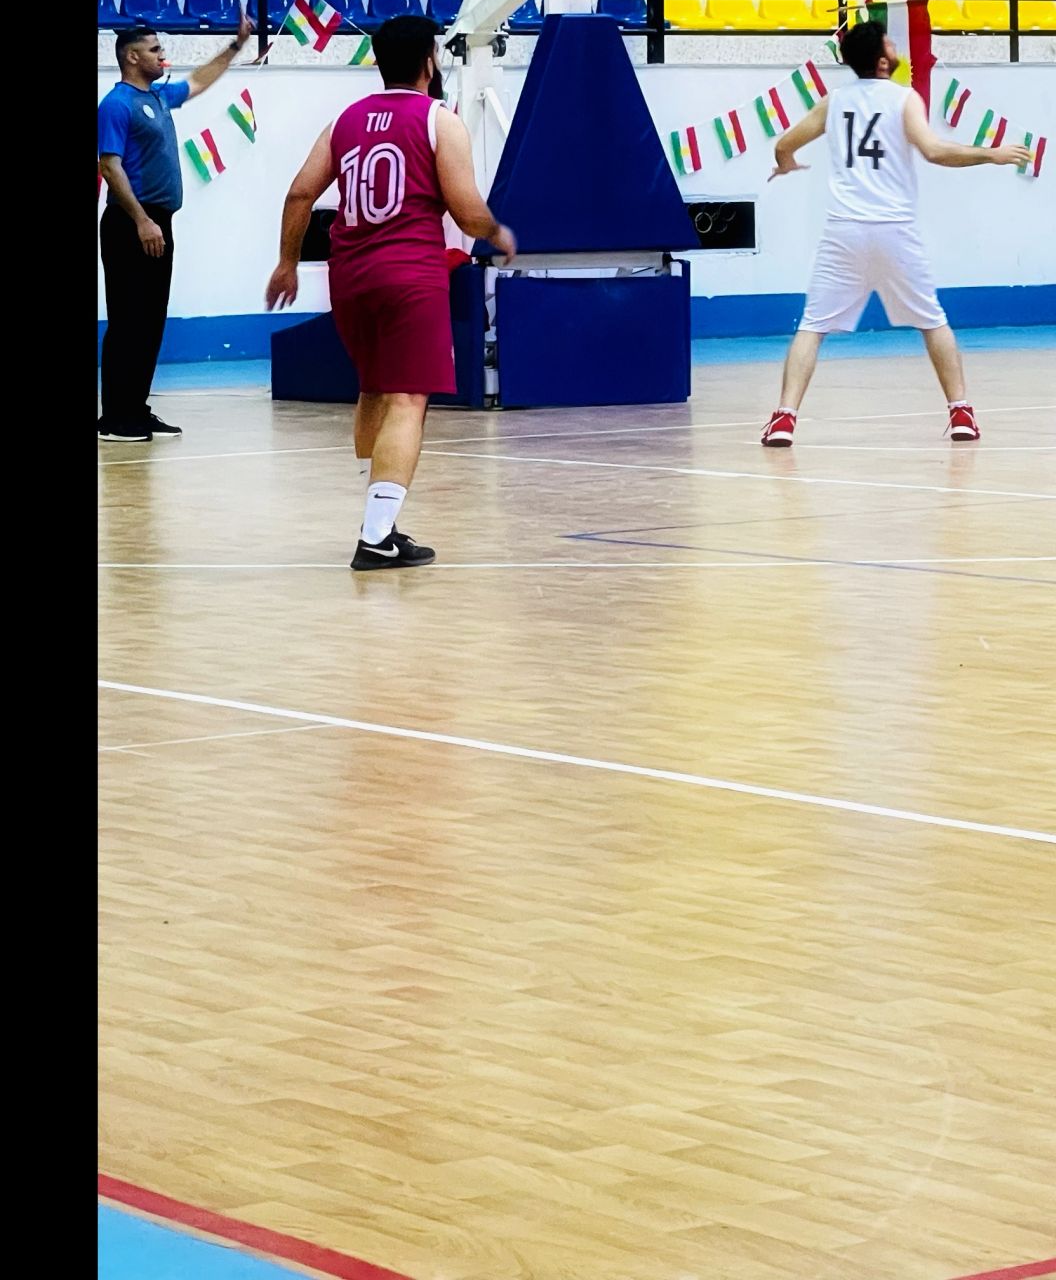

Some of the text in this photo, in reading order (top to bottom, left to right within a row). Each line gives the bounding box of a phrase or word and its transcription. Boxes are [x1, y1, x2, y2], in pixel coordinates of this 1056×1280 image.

[366, 111, 394, 133] TIU
[843, 111, 886, 170] 14
[340, 142, 406, 227] 10
